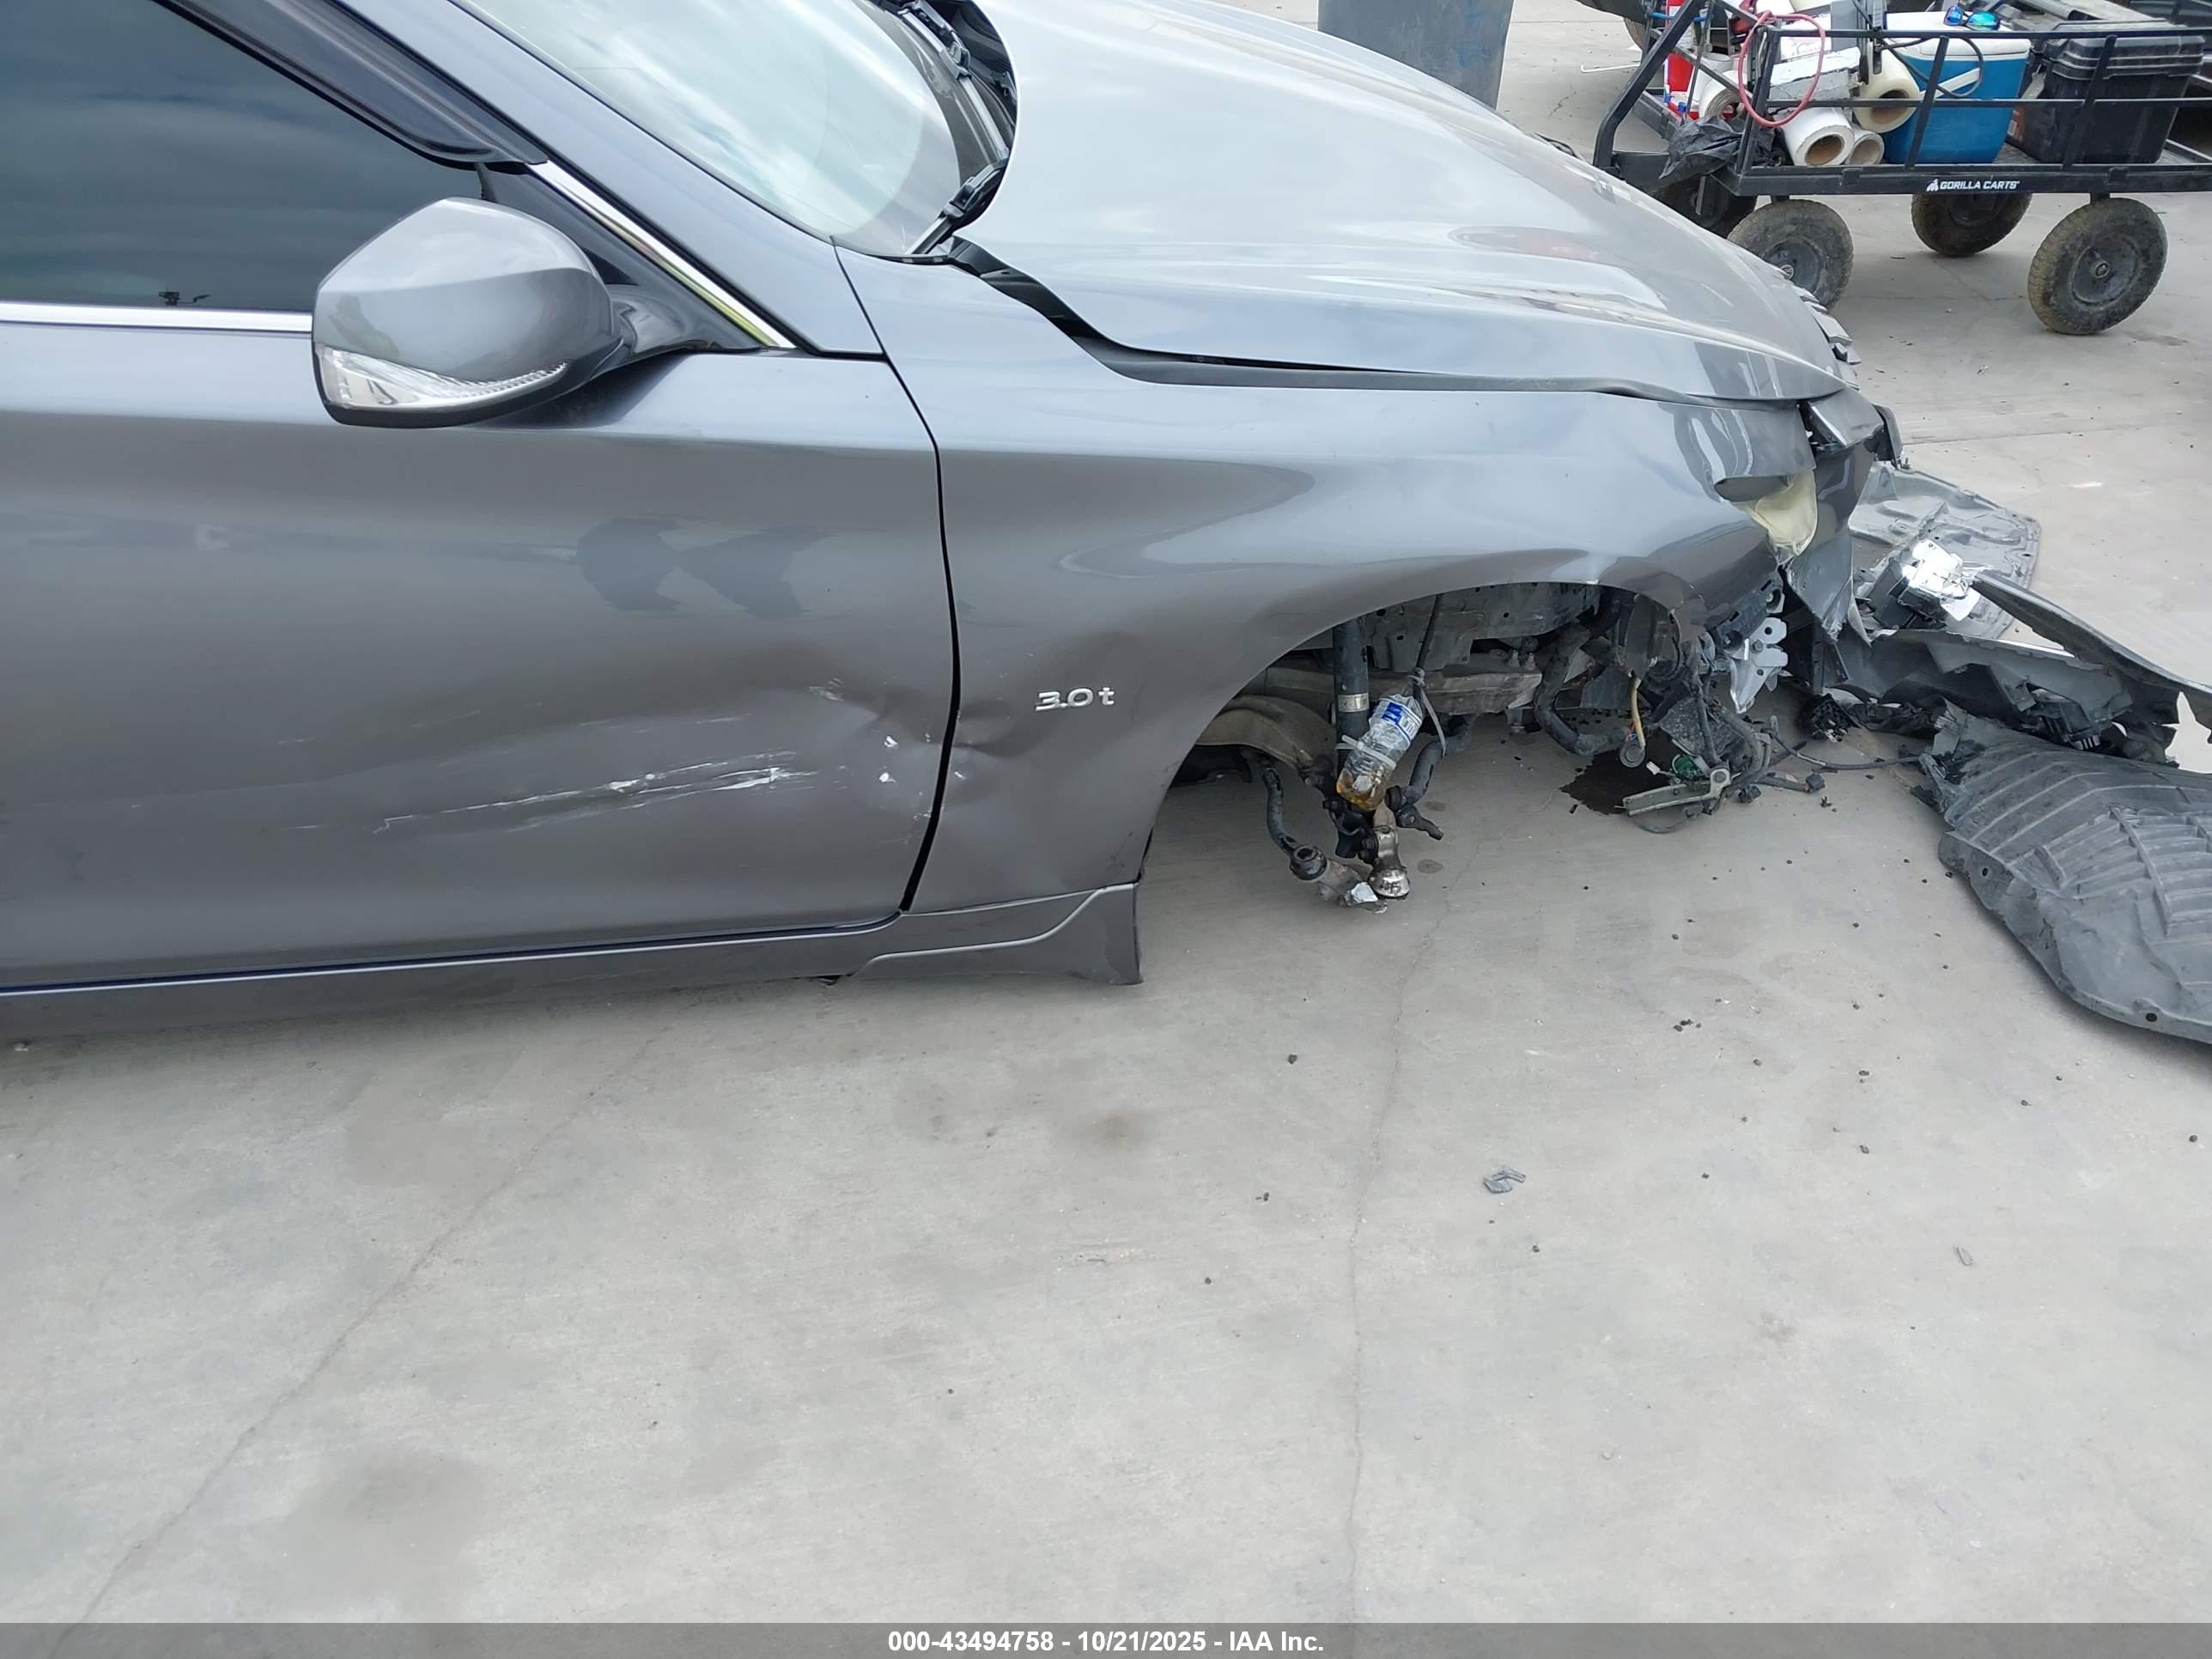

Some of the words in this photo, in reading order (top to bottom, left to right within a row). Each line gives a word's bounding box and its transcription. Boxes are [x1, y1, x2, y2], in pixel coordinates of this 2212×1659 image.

[1940, 180, 1981, 190] GORILLA
[1983, 180, 2017, 190] CARTS
[1036, 688, 1094, 711] 3.0
[1098, 687, 1115, 705] t
